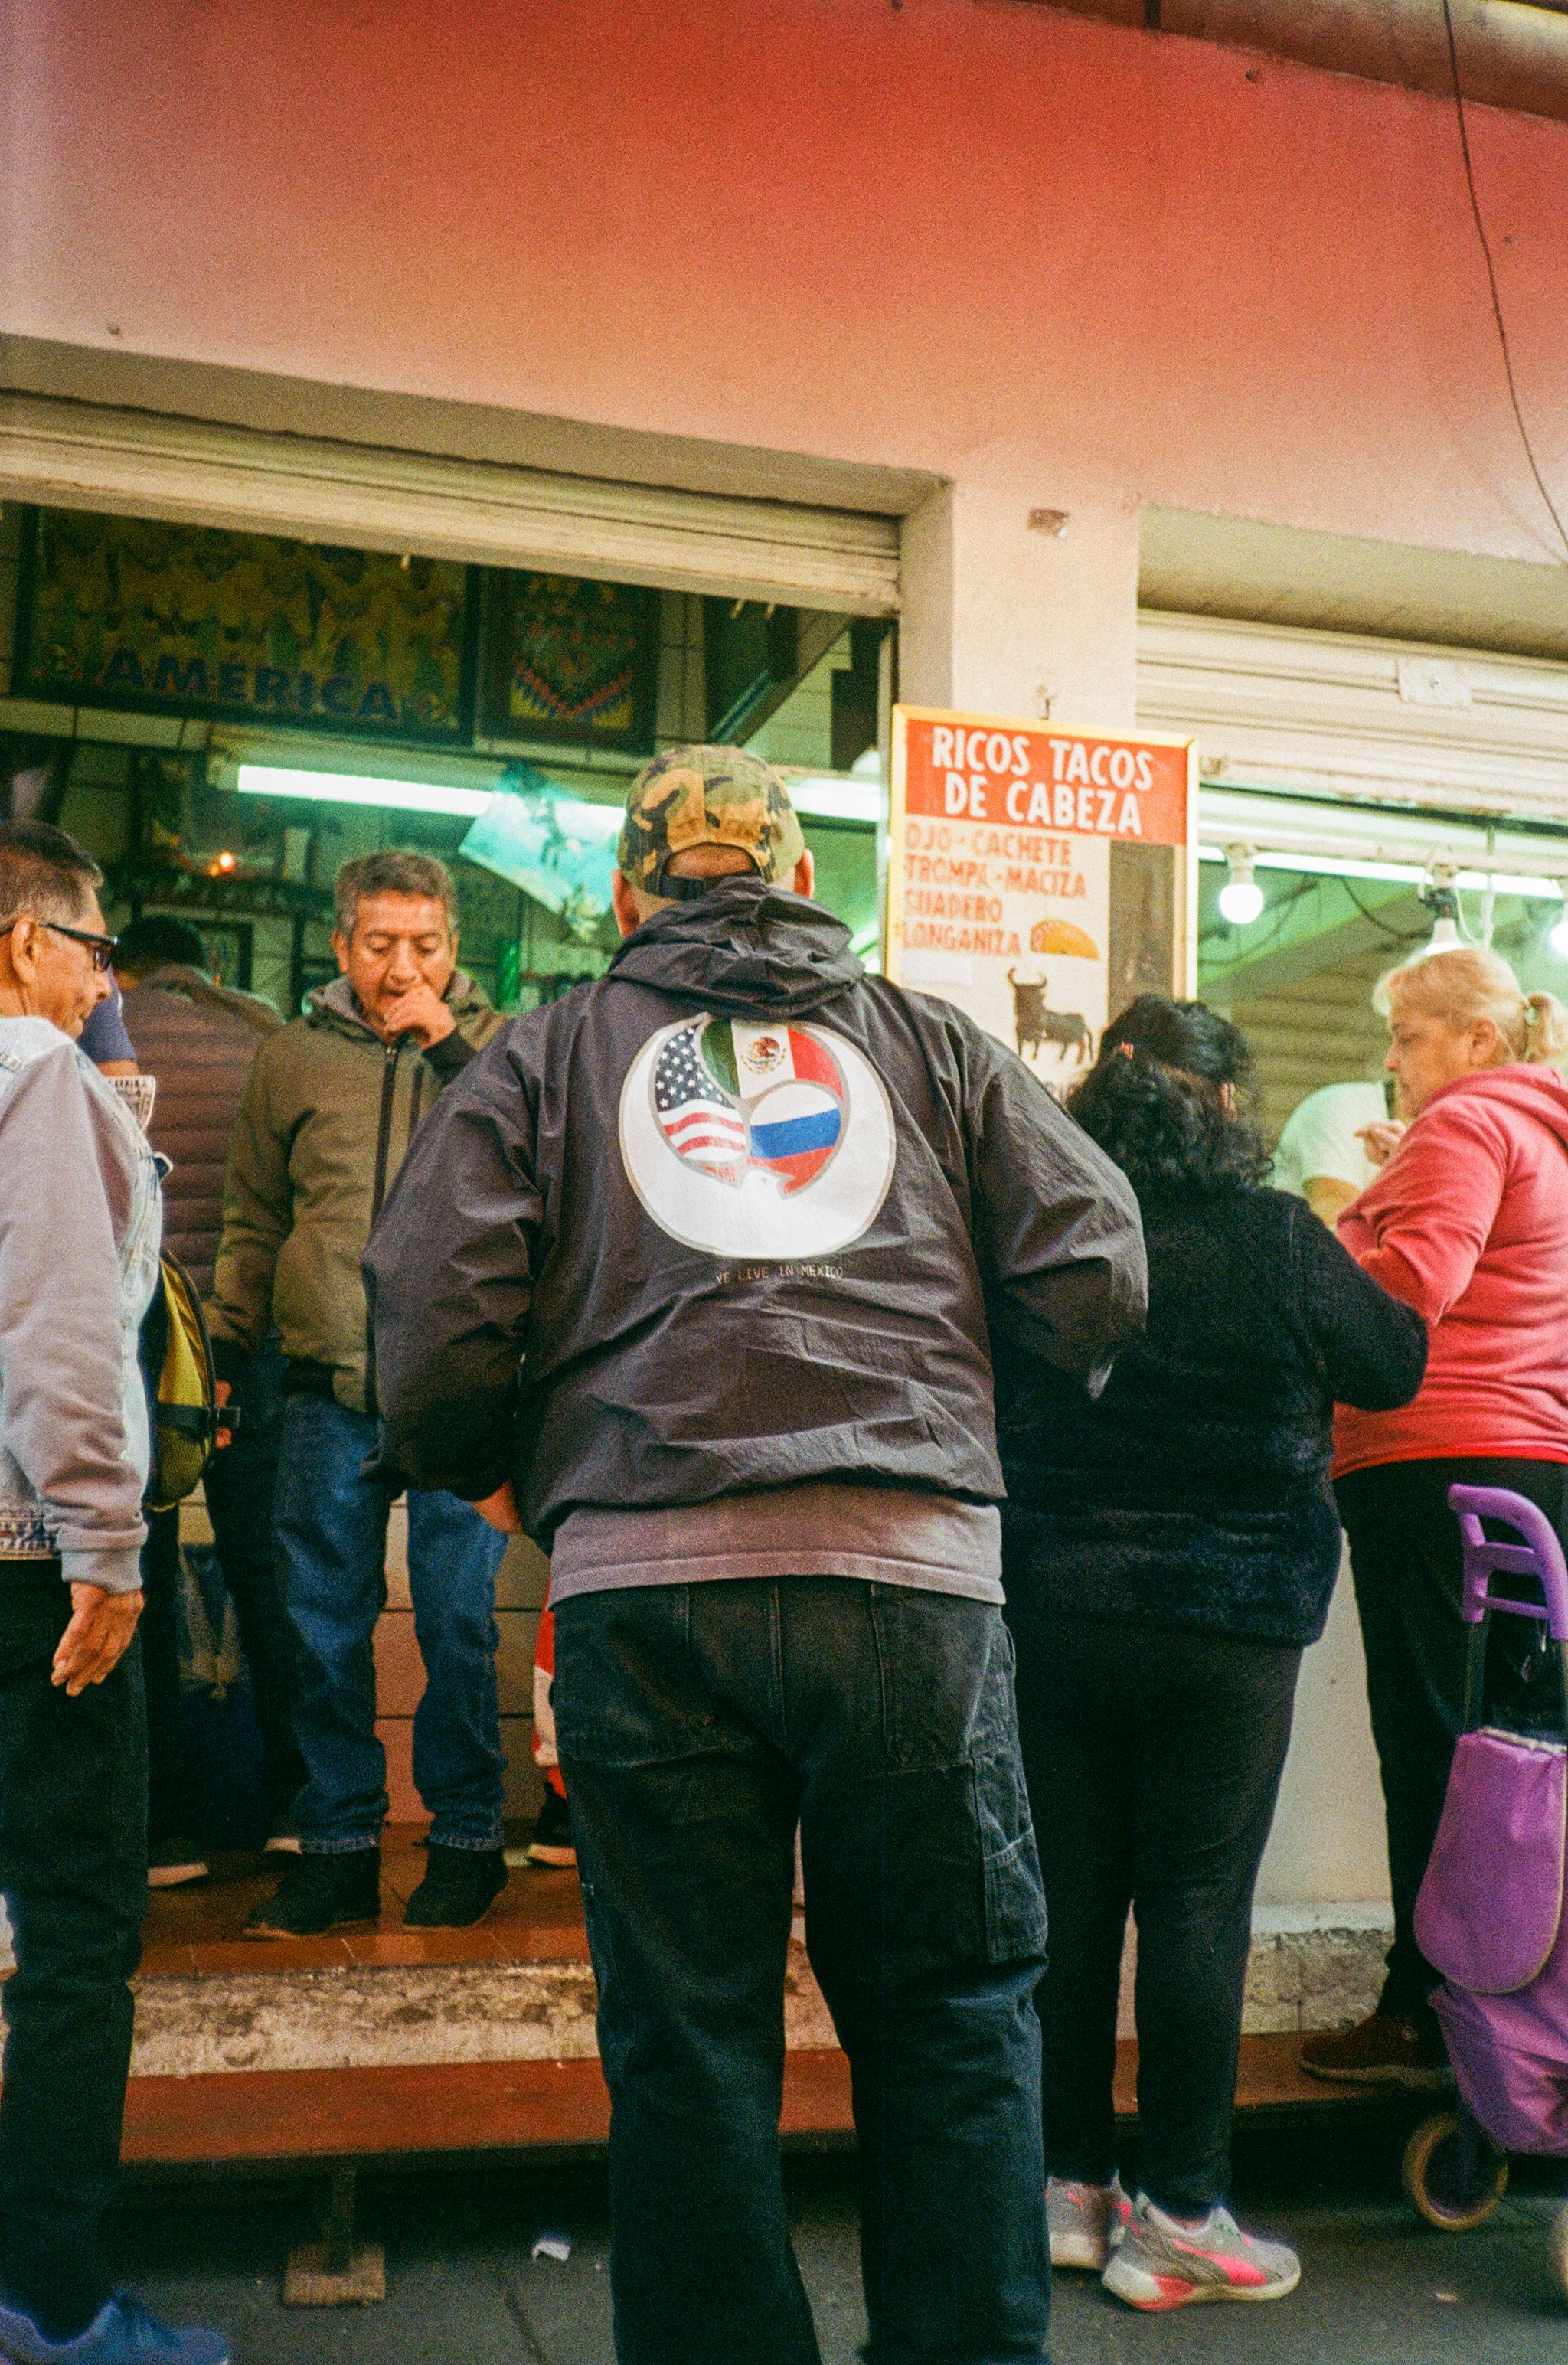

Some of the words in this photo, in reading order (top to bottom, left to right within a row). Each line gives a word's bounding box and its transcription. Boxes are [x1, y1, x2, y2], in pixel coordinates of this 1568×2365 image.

[102, 648, 399, 719] AMÉRICA
[933, 726, 1030, 776] RICOS
[1048, 739, 1154, 790] TACOS
[945, 772, 988, 818] DE
[1006, 781, 1142, 835] CABEZA
[905, 822, 952, 852] OJO
[972, 828, 1072, 866] CACHETE
[1004, 866, 1087, 899] MACIZA
[905, 888, 1004, 923] SUADERO
[902, 921, 1022, 956] LONGANIZA
[738, 1266, 769, 1282] LIVE
[779, 1266, 794, 1278] IN
